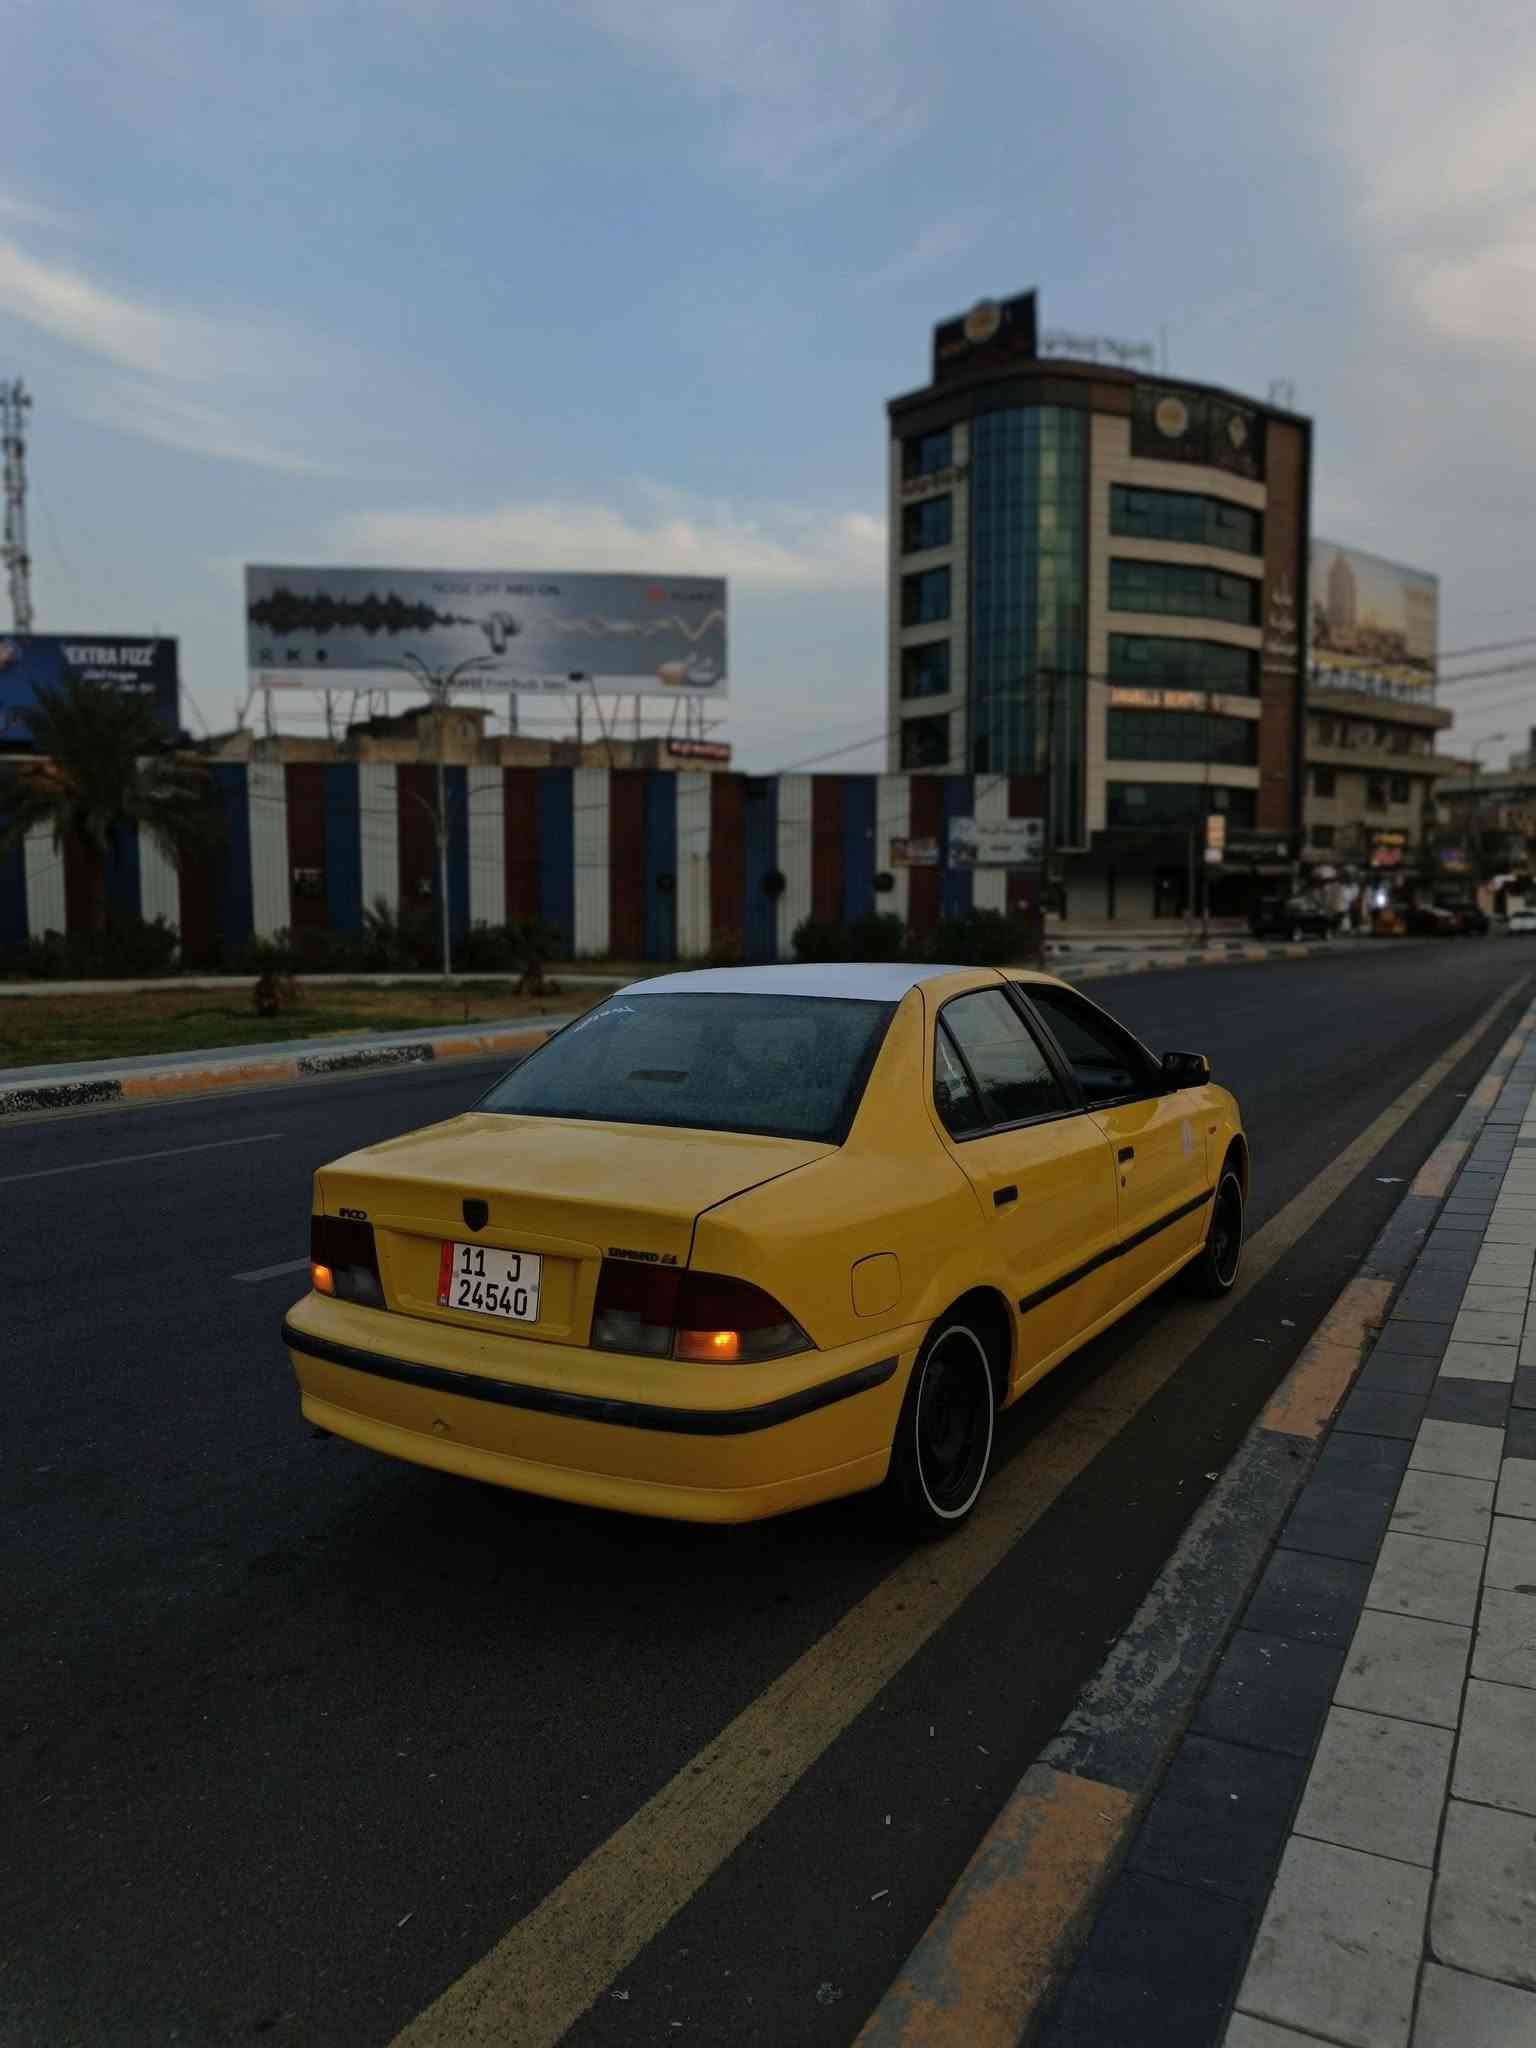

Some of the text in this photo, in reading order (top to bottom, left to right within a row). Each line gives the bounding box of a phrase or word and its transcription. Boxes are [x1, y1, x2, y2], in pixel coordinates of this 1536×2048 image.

[66, 647, 154, 666] EXTRA FIZZ
[461, 1247, 521, 1282] 11 J
[458, 1279, 528, 1316] 24540
